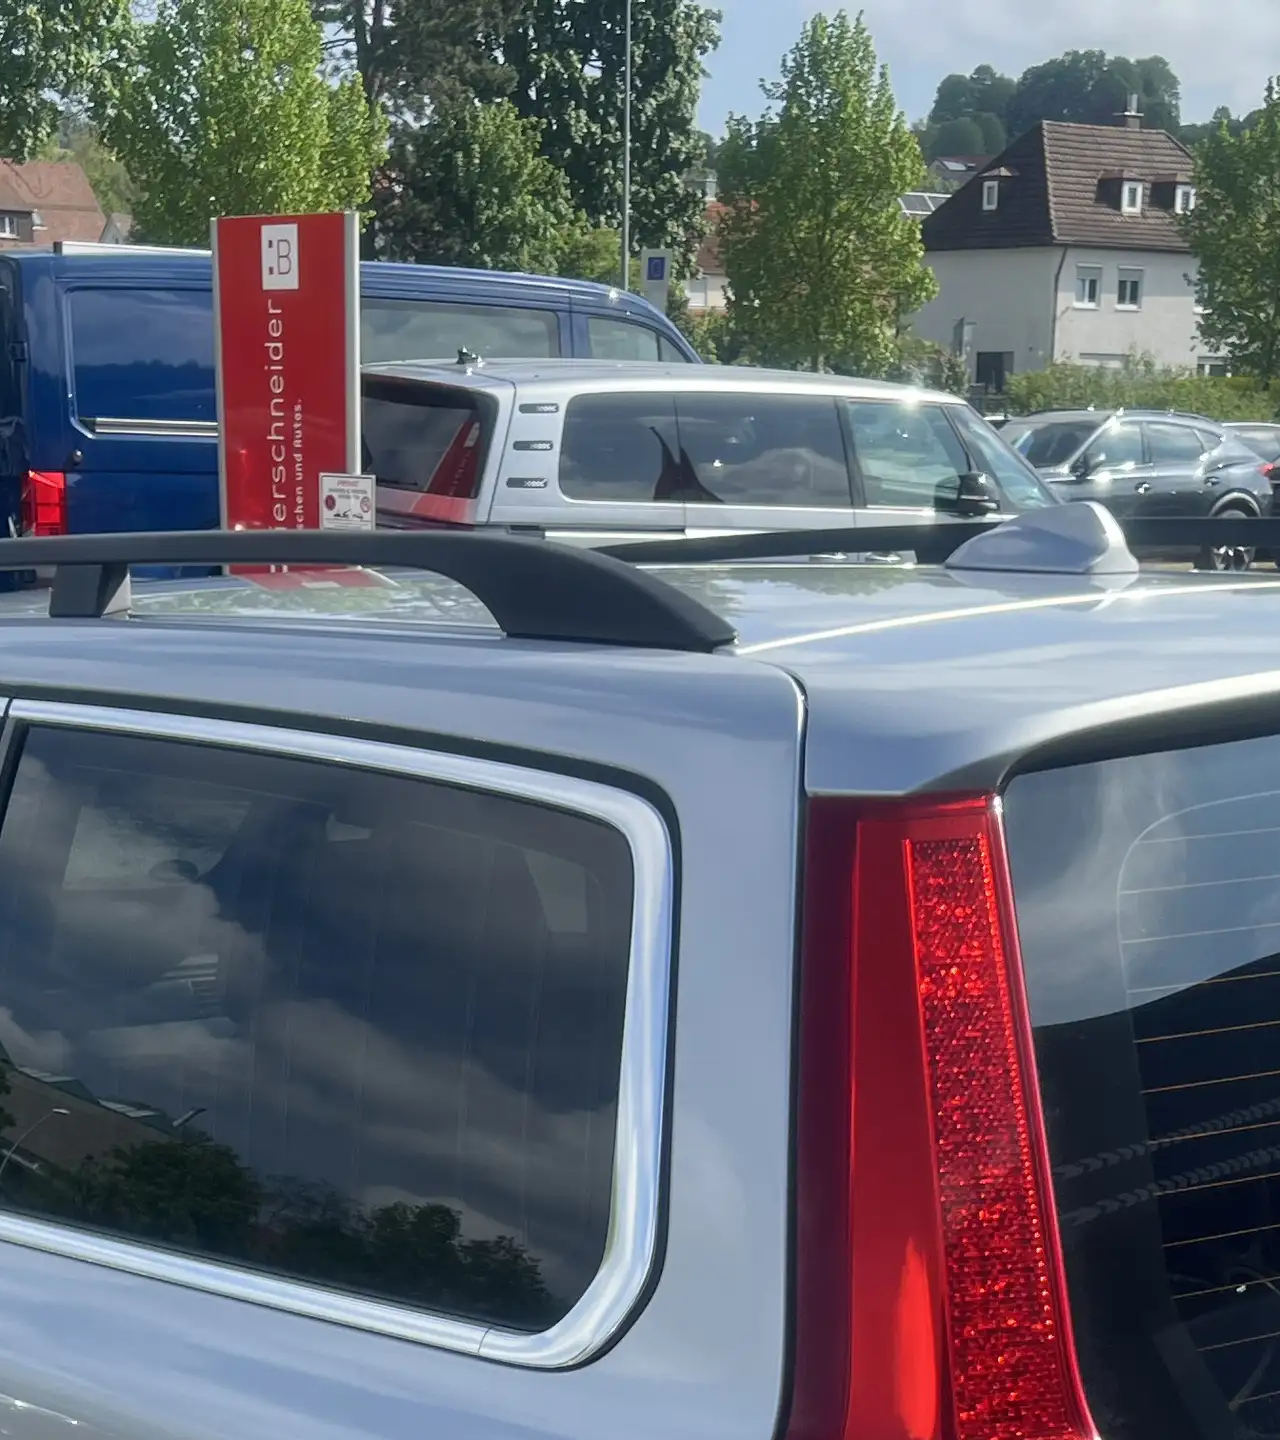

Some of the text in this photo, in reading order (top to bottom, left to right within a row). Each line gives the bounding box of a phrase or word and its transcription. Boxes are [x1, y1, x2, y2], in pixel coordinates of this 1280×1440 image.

[264, 299, 287, 530] ierschneider
[293, 453, 304, 481] und
[294, 486, 304, 530] schen
